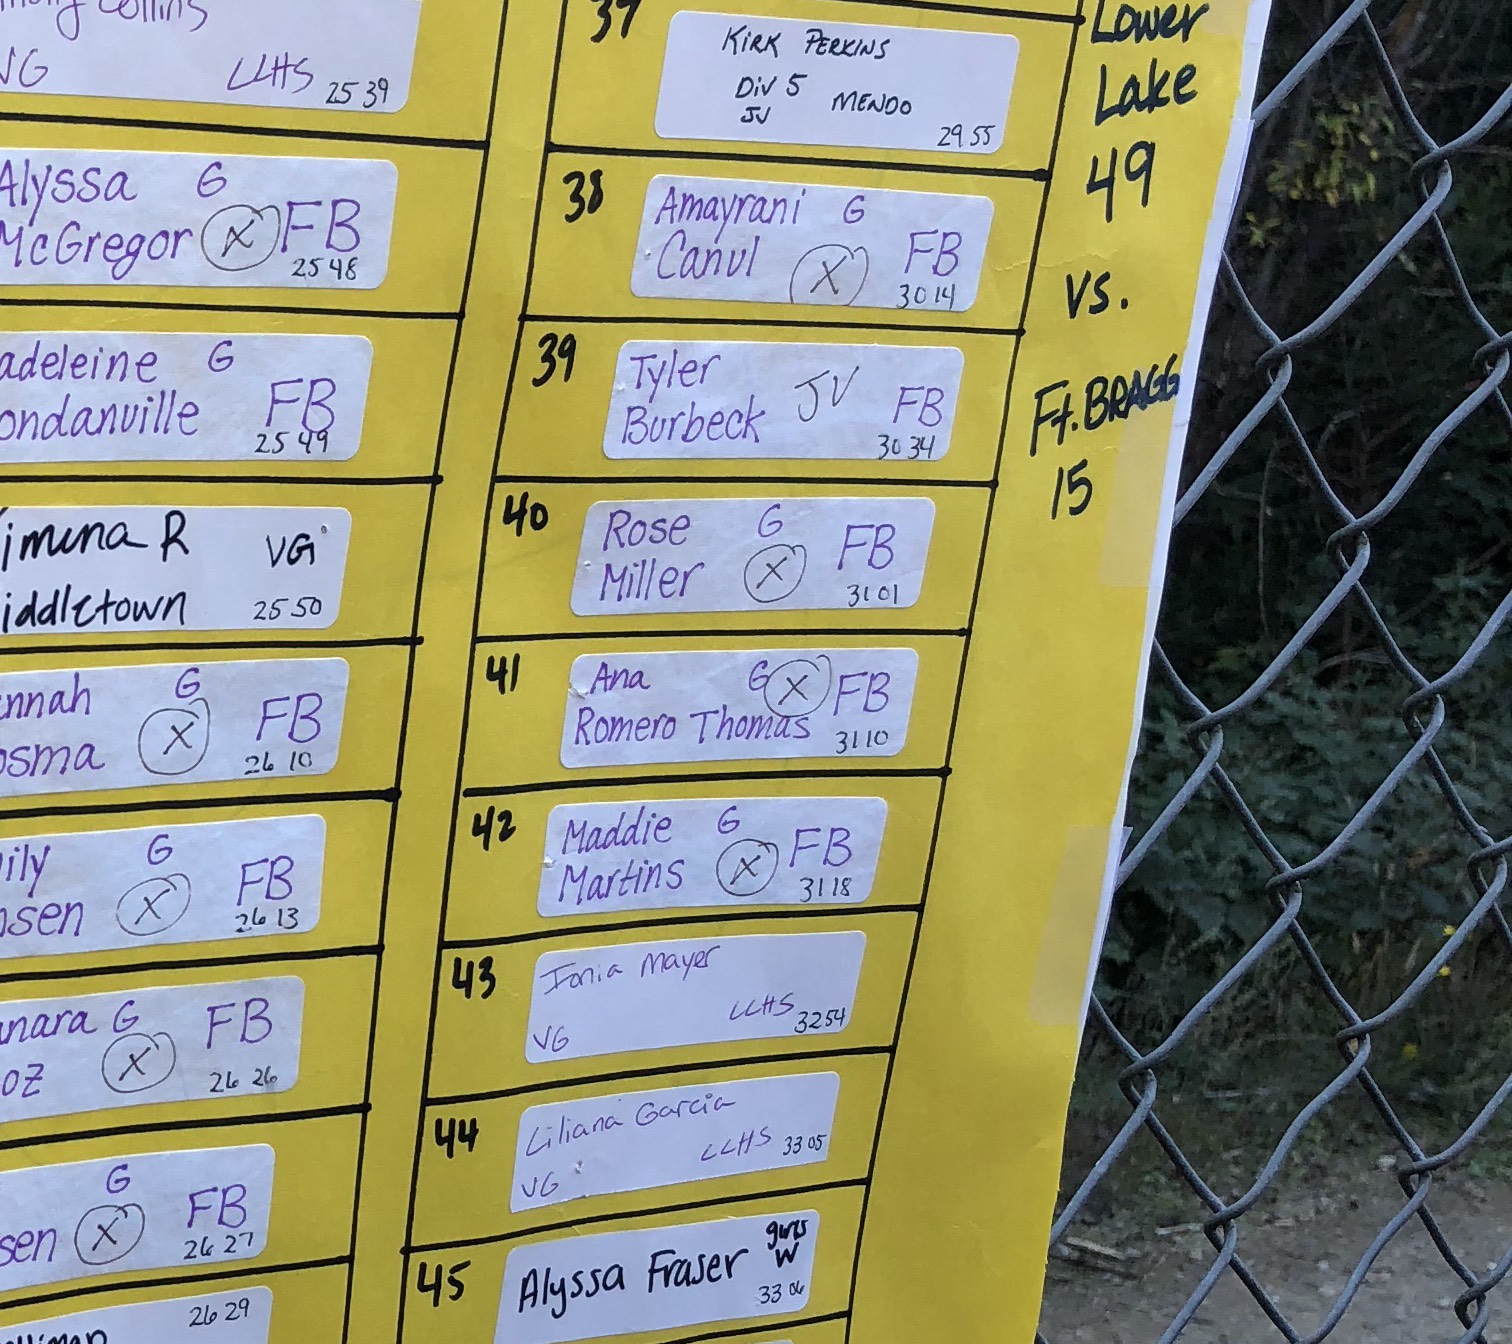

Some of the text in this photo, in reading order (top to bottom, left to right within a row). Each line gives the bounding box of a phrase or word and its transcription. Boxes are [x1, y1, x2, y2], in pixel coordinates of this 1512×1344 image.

[832, 91, 912, 115] MENDO
[1095, 57, 1198, 126] Lake
[1086, 141, 1156, 223] 49
[654, 186, 800, 245] Amayrani
[657, 229, 760, 279] Canul
[208, 340, 234, 372] G
[532, 332, 576, 387] 39
[630, 349, 859, 422] Tyler JV
[622, 386, 944, 445] Burbeck FB
[1051, 459, 1092, 520] 15
[502, 491, 548, 537] 40
[603, 503, 783, 551] Rose G
[599, 558, 705, 602] Miller
[590, 662, 650, 694] Ana
[575, 704, 813, 745] Romero Thomas
[472, 805, 516, 851] 42
[562, 806, 671, 855] Maddie
[558, 827, 852, 905] Martins FB
[452, 956, 496, 999] 43
[207, 998, 272, 1049] FB
[636, 1093, 736, 1126] Garcia
[187, 1184, 246, 1228] FB
[417, 1260, 471, 1307] 45
[518, 1248, 749, 1319] Alyssa Fraser
